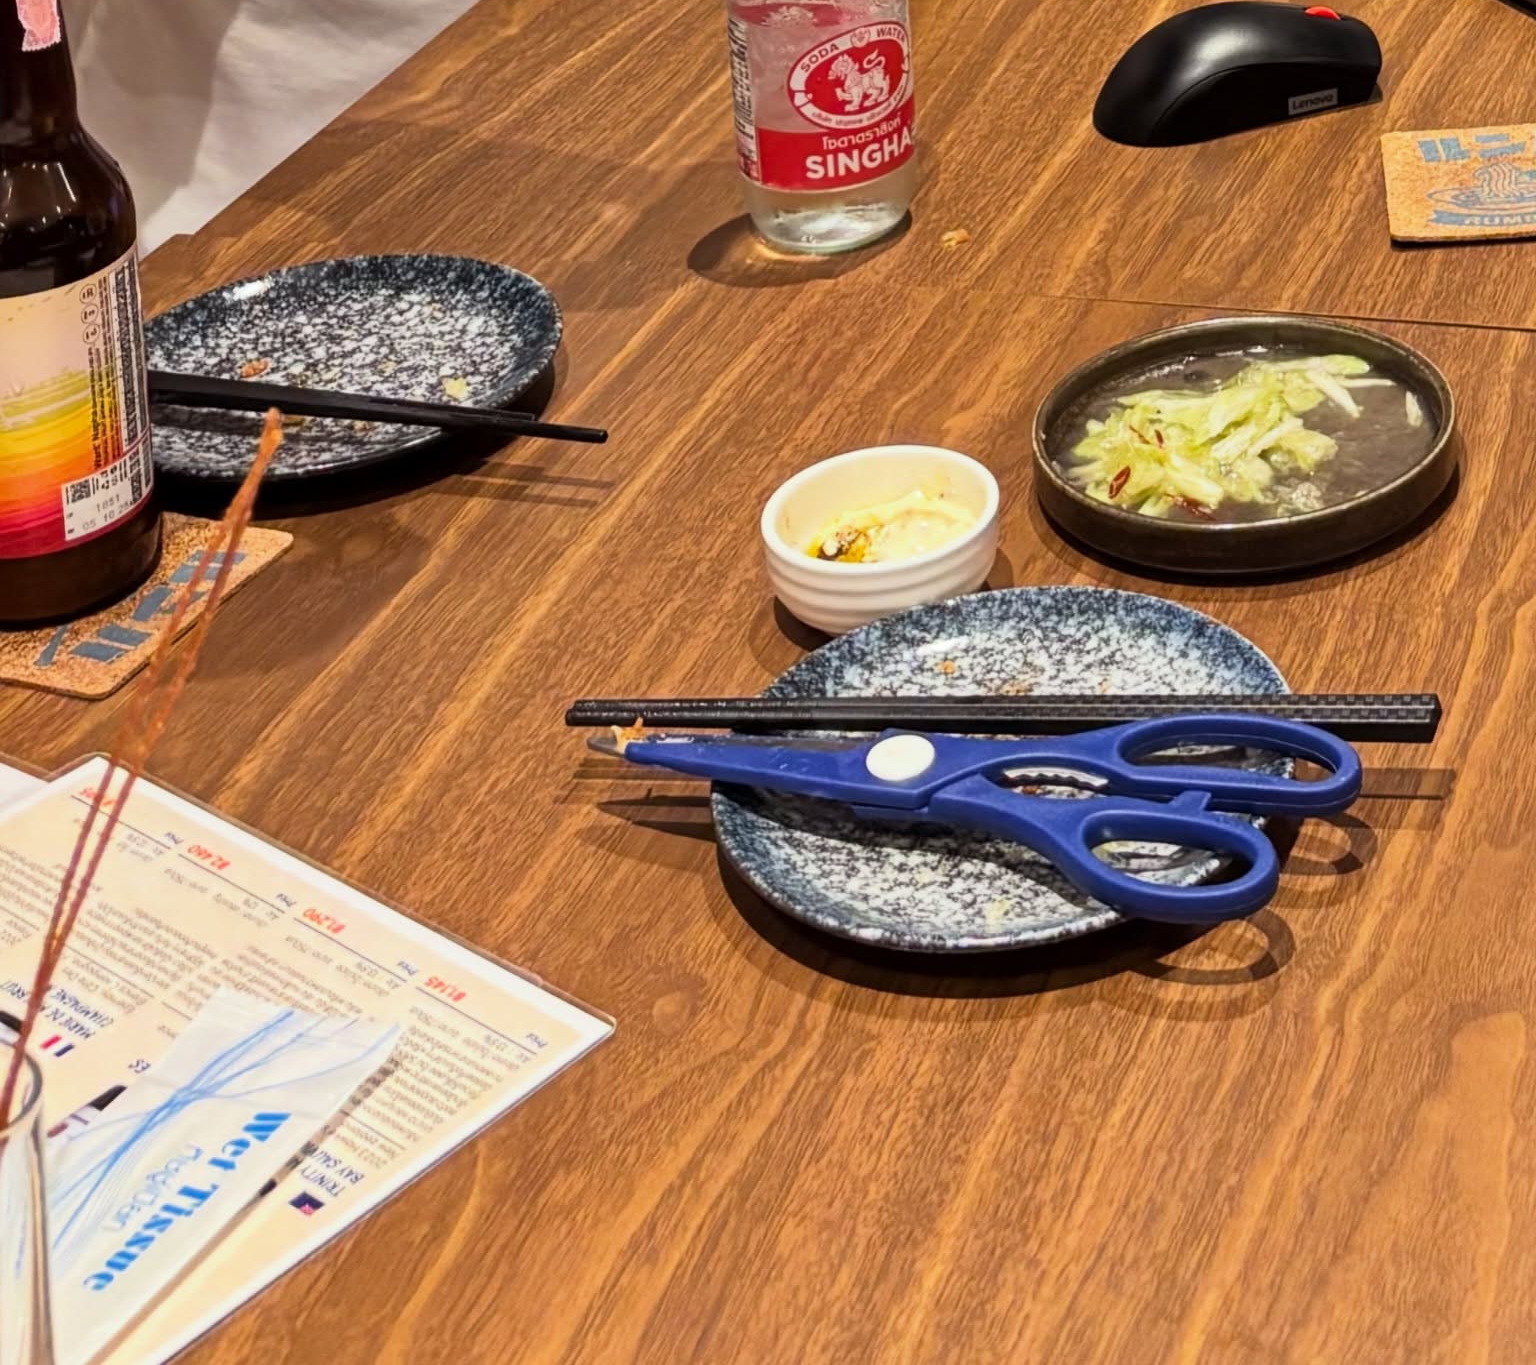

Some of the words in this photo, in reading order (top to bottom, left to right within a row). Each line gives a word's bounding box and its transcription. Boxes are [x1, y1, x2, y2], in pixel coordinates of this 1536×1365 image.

[799, 43, 840, 72] SODA
[1292, 94, 1334, 110] Lenovo
[805, 126, 912, 179] SINGHA
[208, 1110, 291, 1175] Wet
[296, 1163, 346, 1197] TRINITY
[82, 1181, 218, 1292] Tissue
